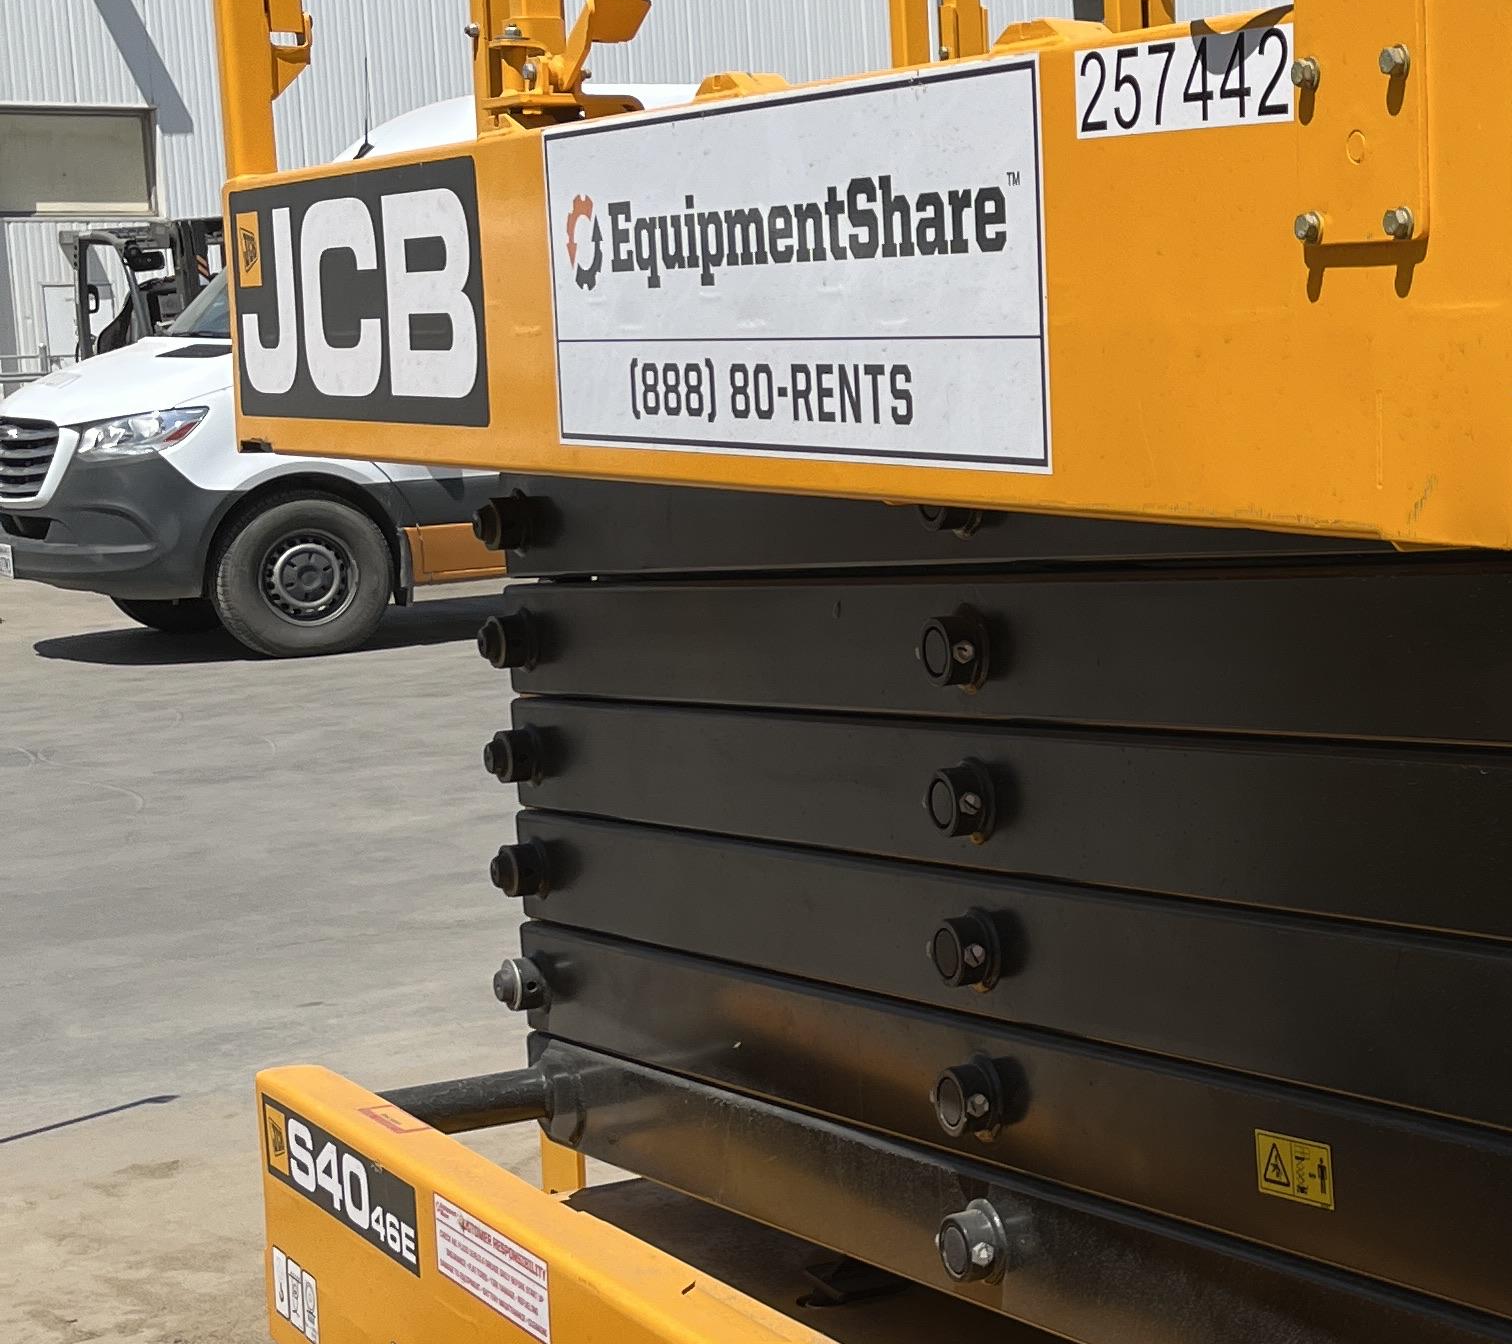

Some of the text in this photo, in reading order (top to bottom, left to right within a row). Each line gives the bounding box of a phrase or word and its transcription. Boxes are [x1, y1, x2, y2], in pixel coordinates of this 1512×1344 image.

[1080, 27, 1289, 133] 257442
[608, 174, 1007, 289] EquipmentShare
[241, 187, 478, 399] JCB
[630, 358, 914, 426] (888) 80-RENTS
